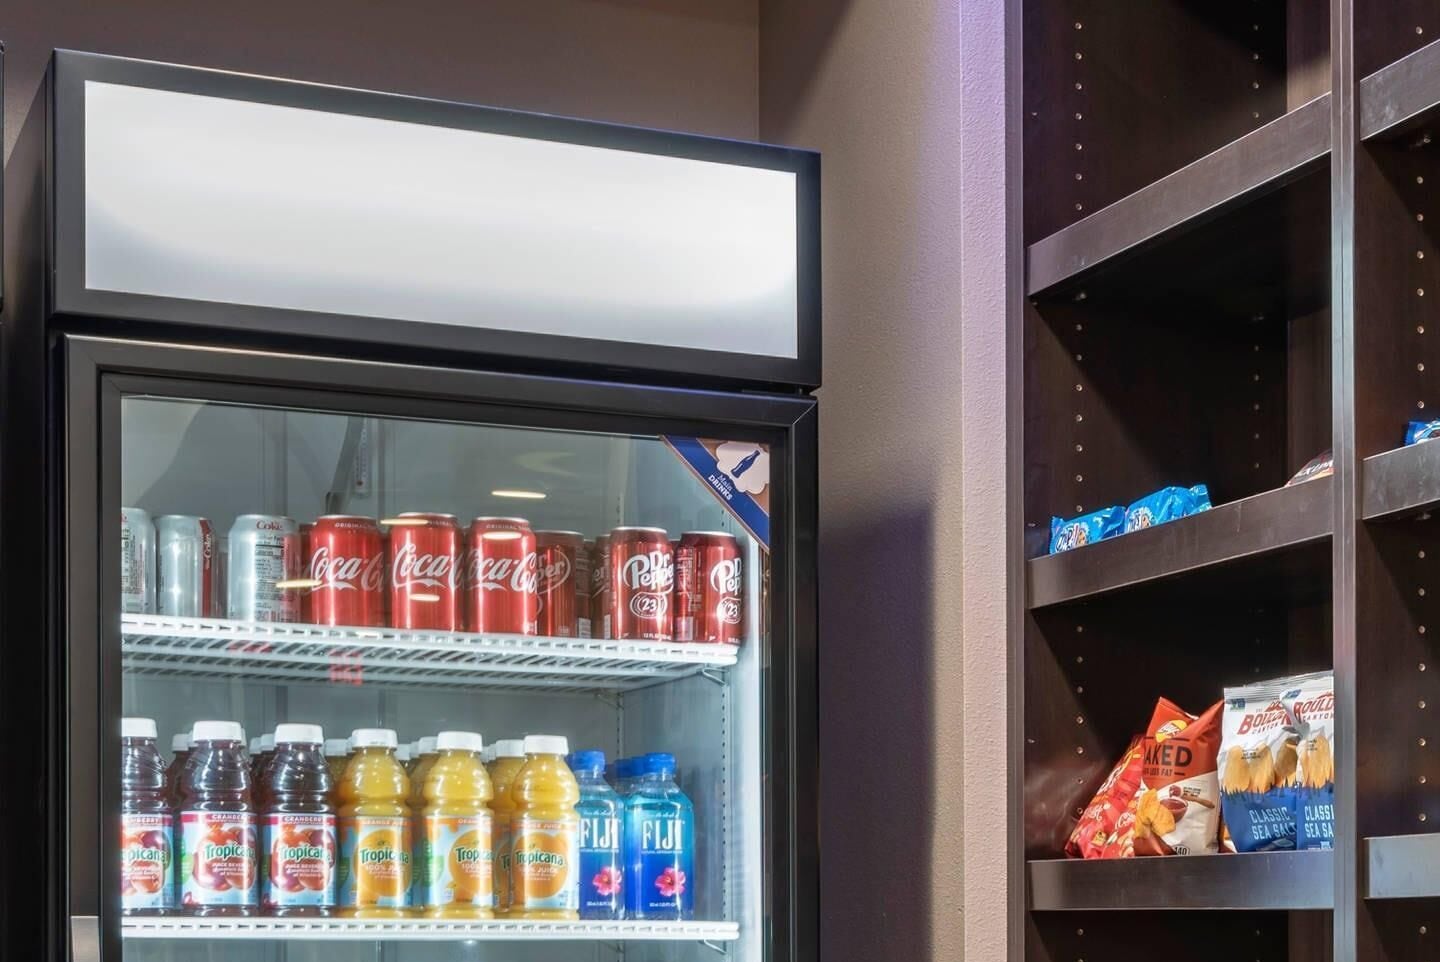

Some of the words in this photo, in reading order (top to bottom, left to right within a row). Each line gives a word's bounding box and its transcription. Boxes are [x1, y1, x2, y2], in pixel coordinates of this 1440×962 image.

[708, 474, 733, 500] DRINKS
[642, 599, 657, 612] 23
[1250, 806, 1290, 824] CLASSIC
[1304, 805, 1334, 821] CLASSI
[579, 818, 619, 849] FIJI
[642, 819, 683, 850] FIJI
[1251, 824, 1271, 841] SEA
[1273, 821, 1297, 841] SALT
[1304, 823, 1321, 838] SEA
